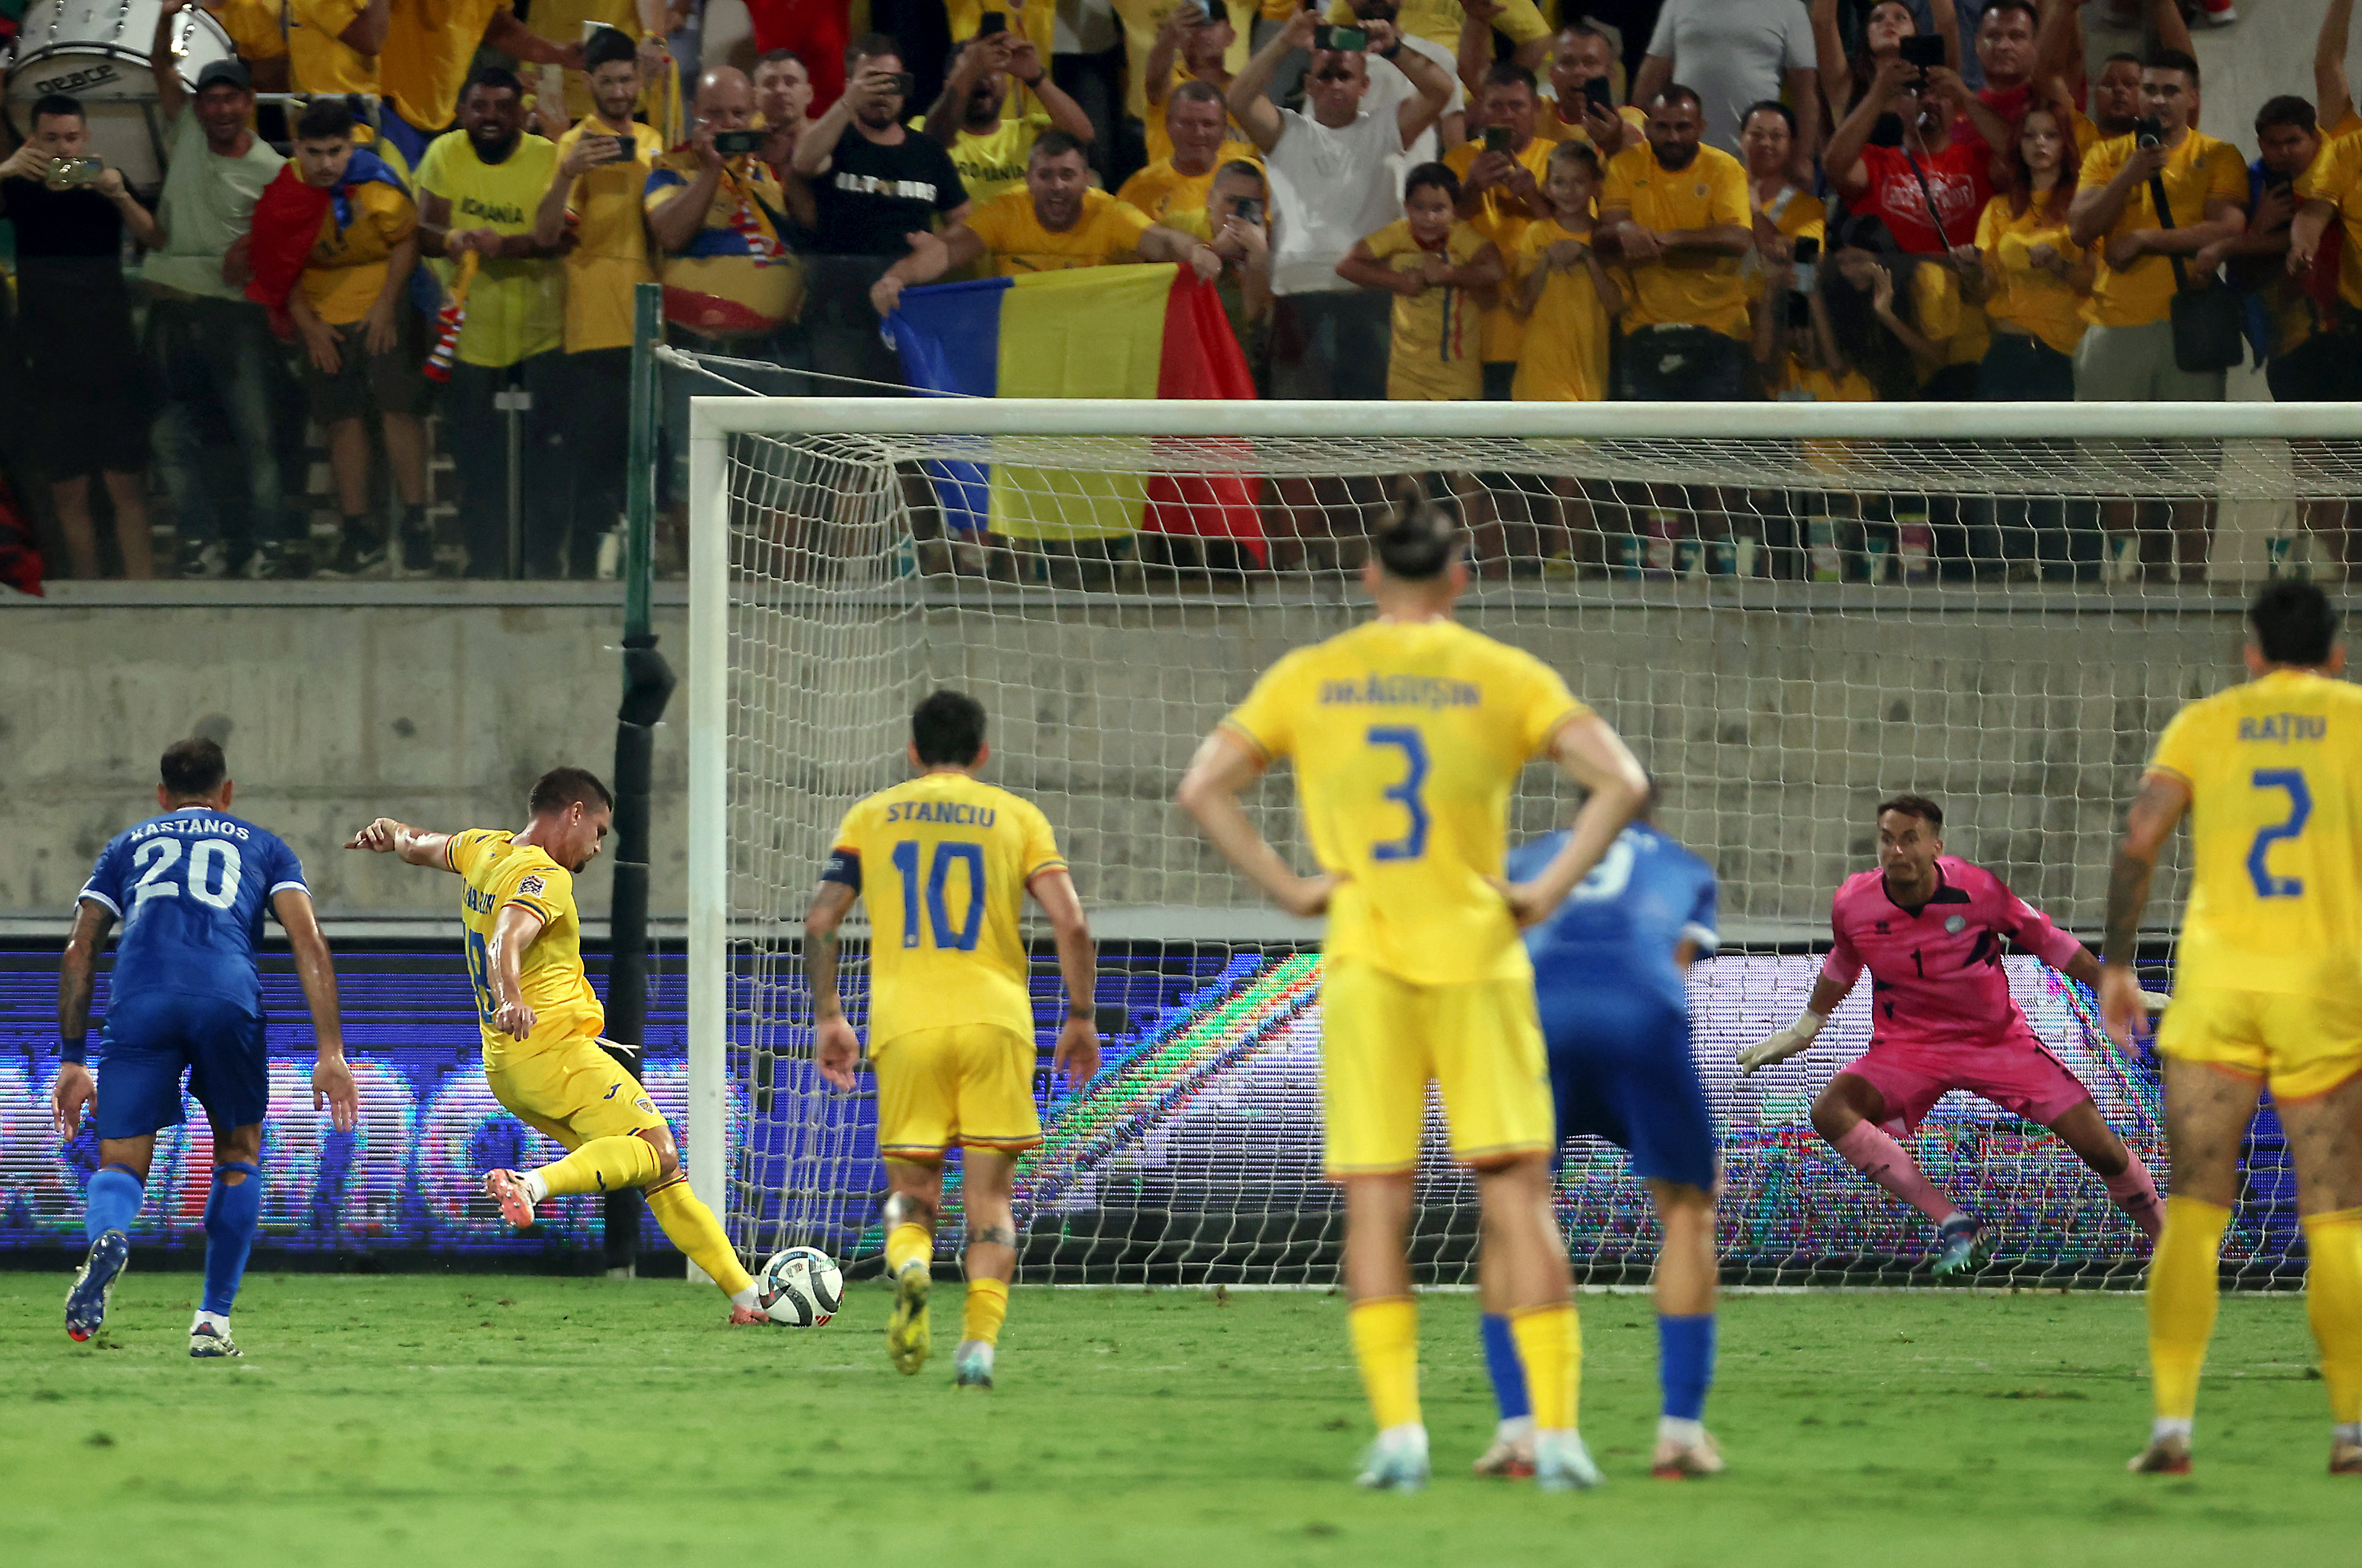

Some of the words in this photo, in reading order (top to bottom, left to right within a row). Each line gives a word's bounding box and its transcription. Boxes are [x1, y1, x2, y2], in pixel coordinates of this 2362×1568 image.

[888, 801, 997, 828] STANCIU
[1366, 724, 1431, 861] 3
[131, 819, 250, 841] KASTANOS
[2243, 767, 2314, 897] 2
[133, 837, 242, 909] 20
[893, 840, 986, 950] 10
[1910, 948, 1924, 979] 1
